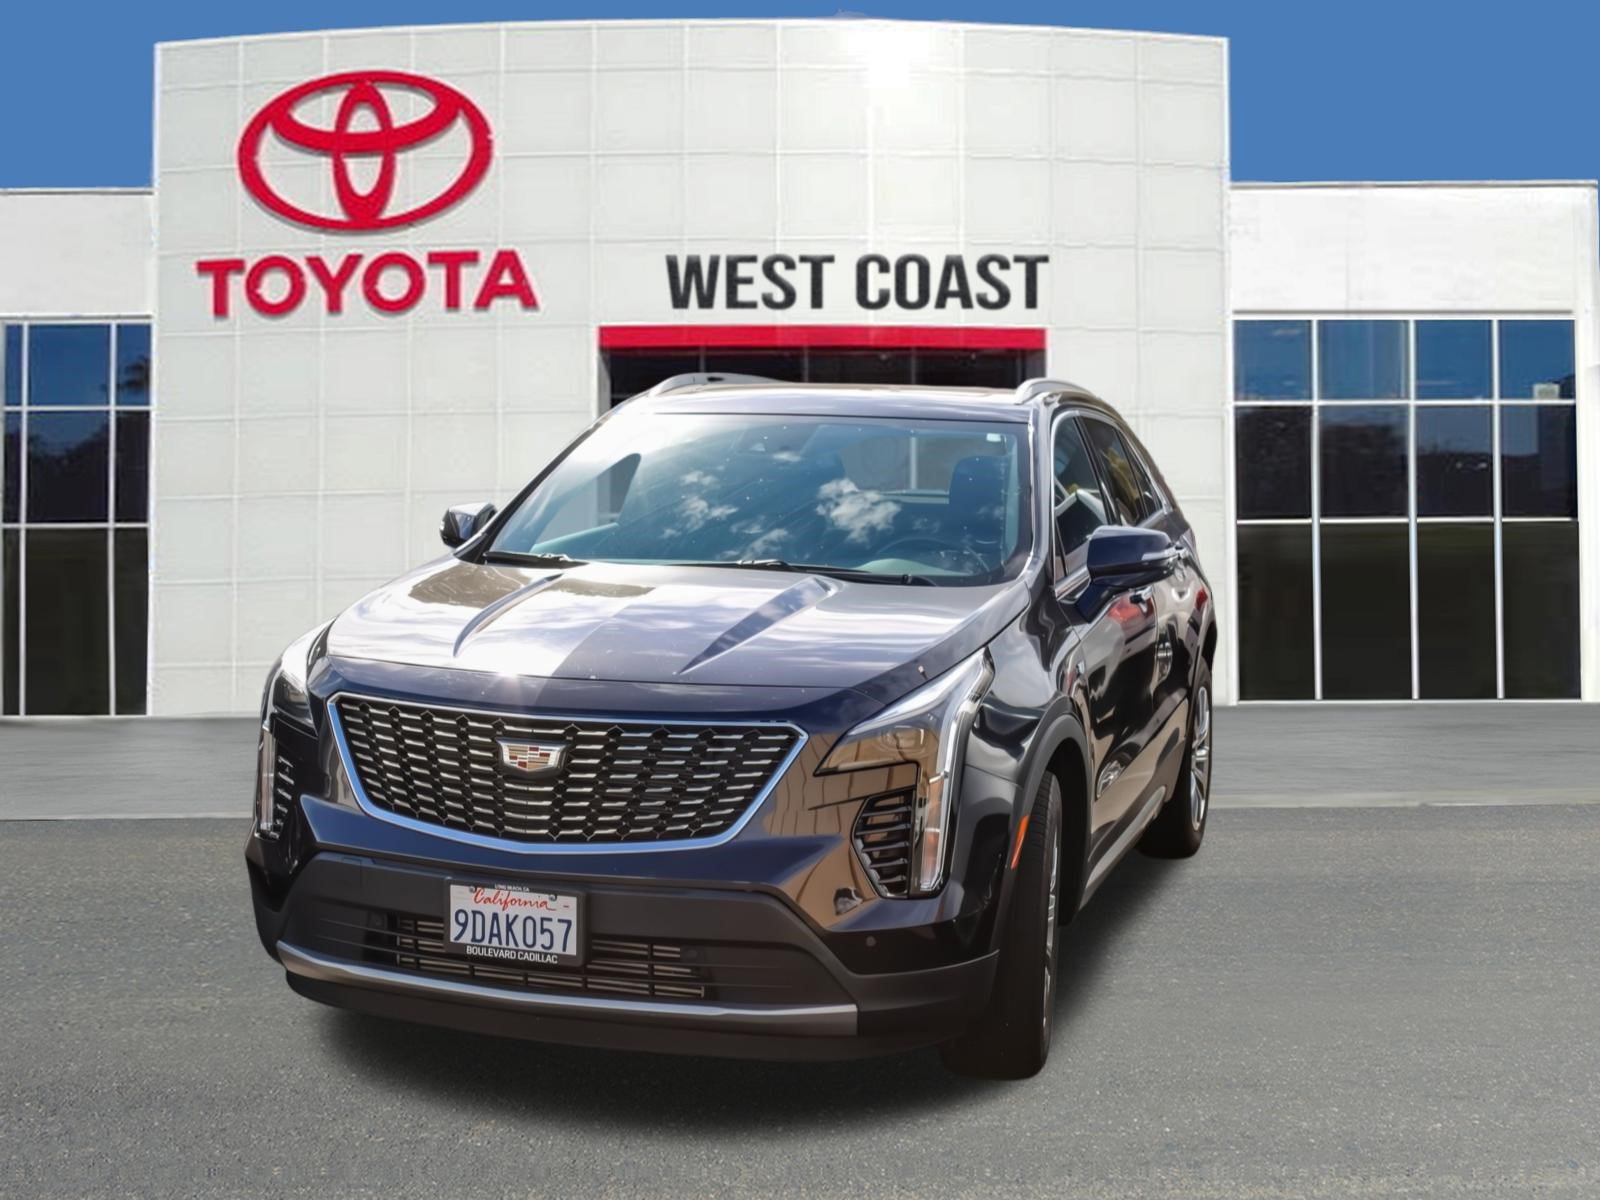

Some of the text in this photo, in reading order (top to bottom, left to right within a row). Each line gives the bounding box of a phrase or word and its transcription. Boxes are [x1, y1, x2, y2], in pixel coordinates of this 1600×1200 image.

[196, 250, 539, 317] TOYOTA
[665, 253, 1049, 311] WEST COAST
[473, 887, 556, 911] California
[453, 909, 572, 952] 9DAK057
[466, 945, 558, 964] BOULEVARD CADILLAC
